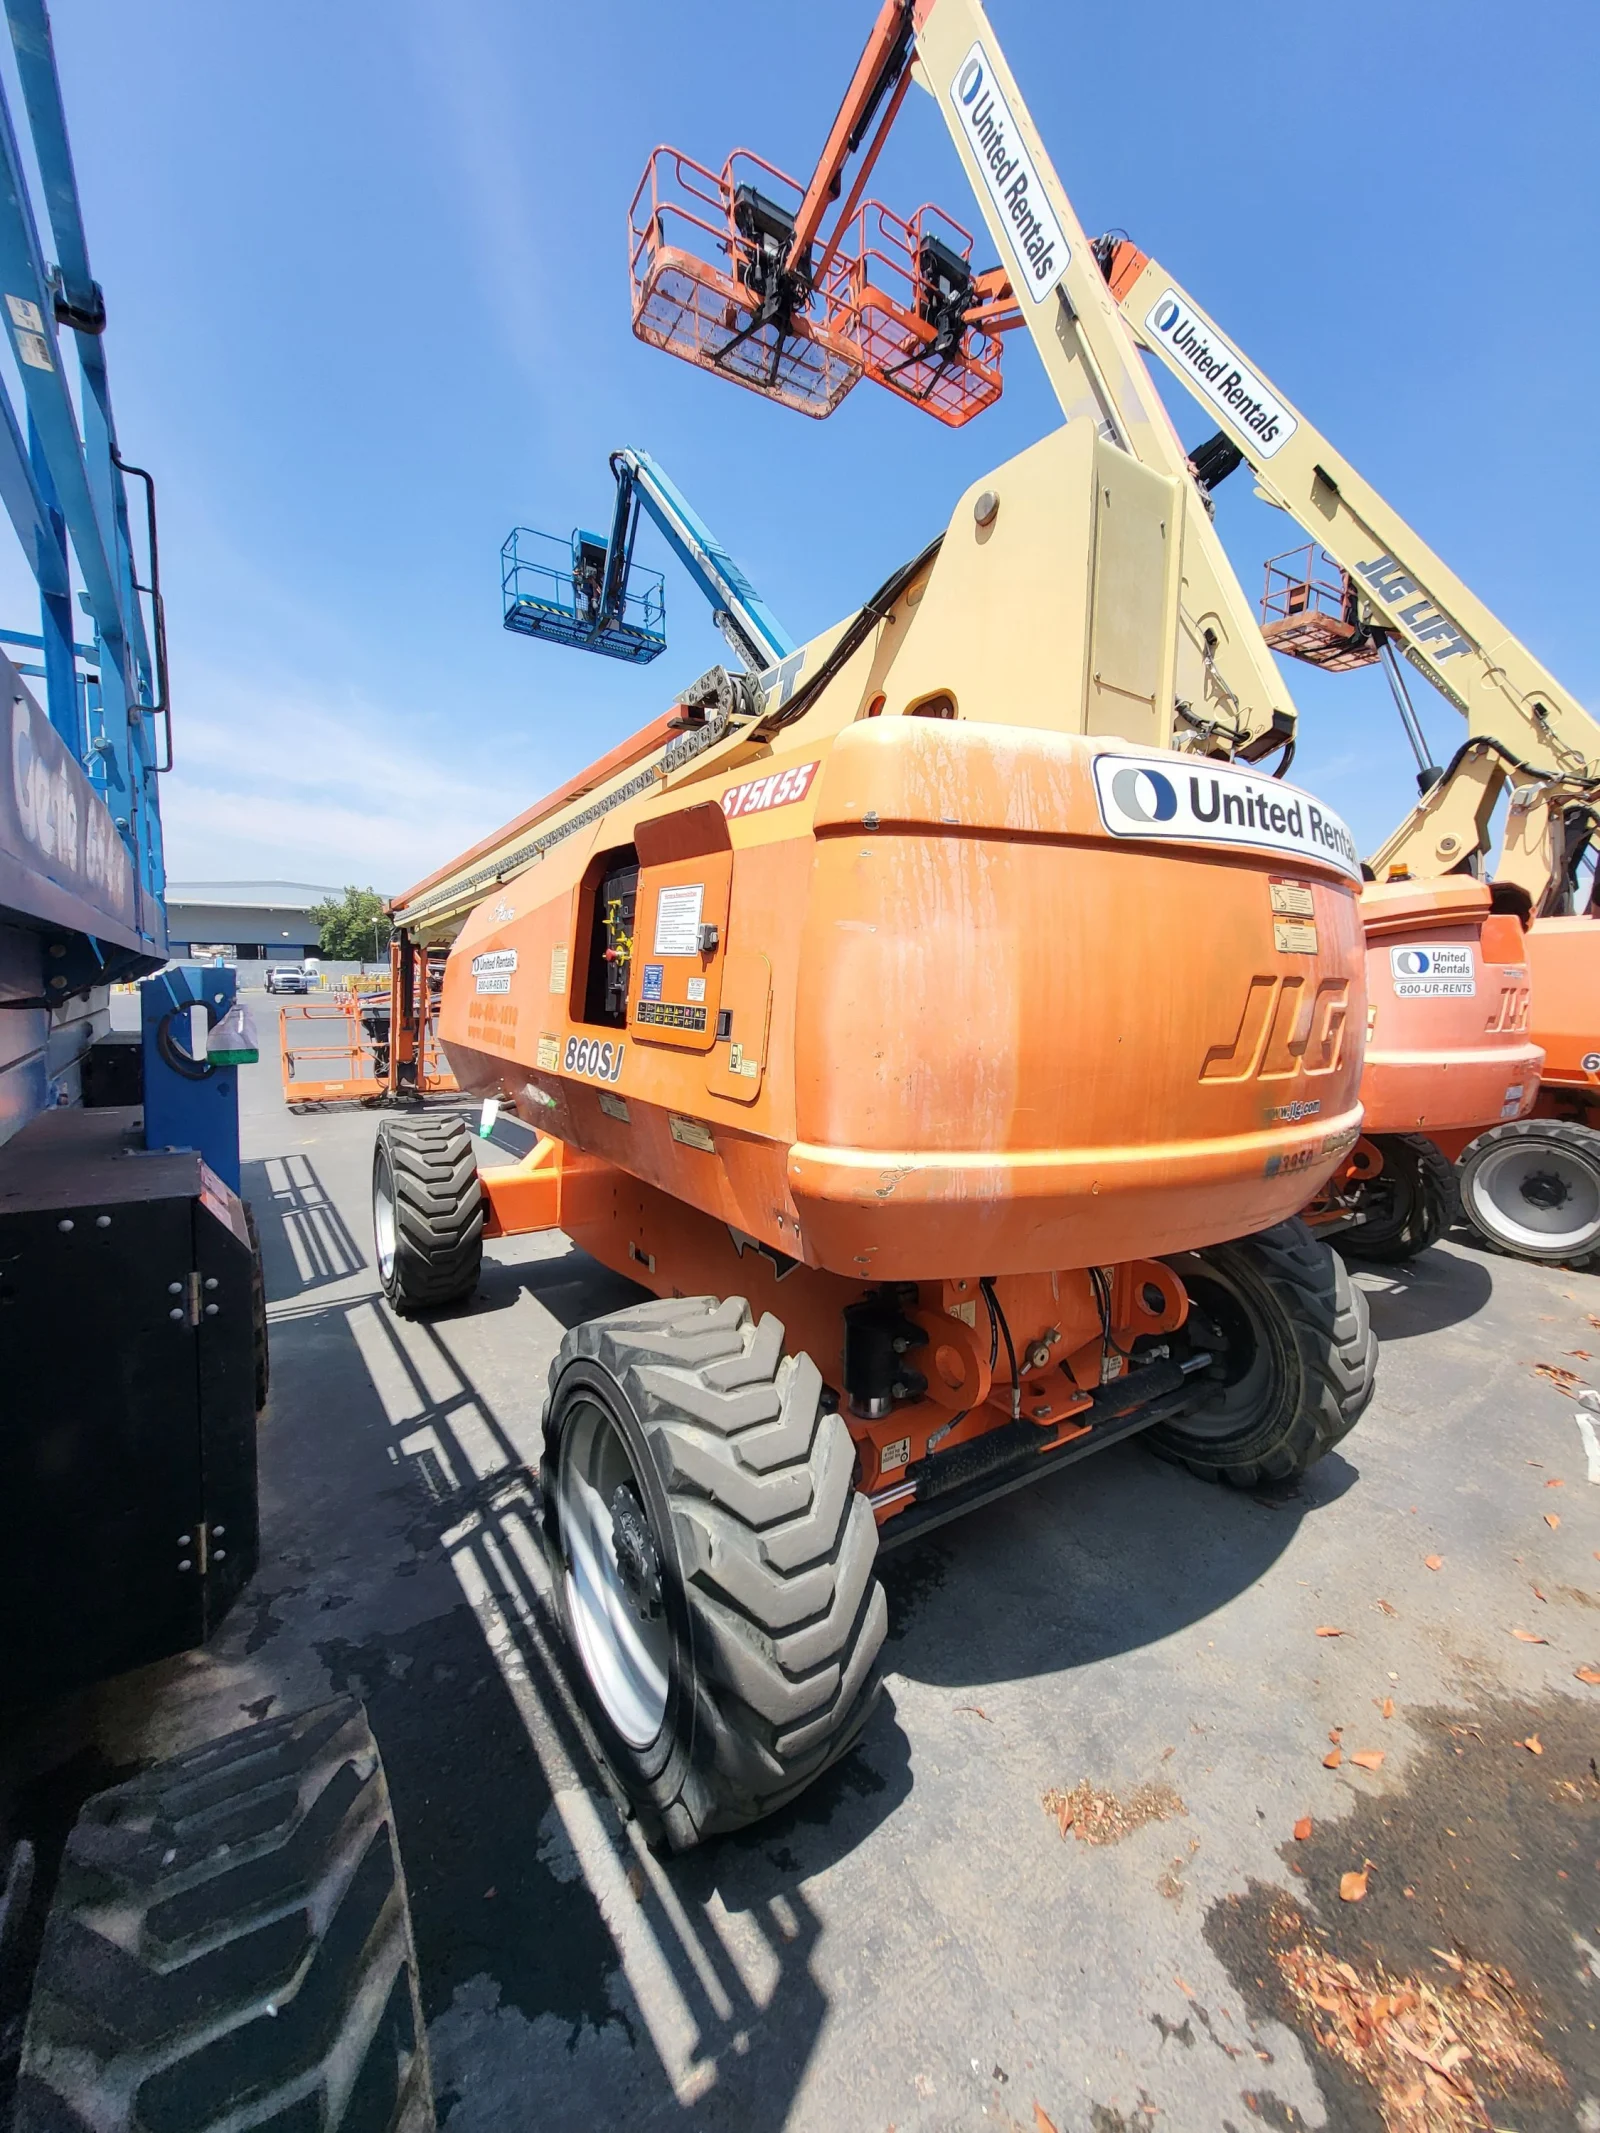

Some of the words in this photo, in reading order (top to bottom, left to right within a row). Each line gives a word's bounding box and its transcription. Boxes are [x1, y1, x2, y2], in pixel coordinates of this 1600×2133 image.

[971, 89, 1019, 187] United
[1004, 171, 1055, 280] Rentals
[1172, 319, 1229, 383] United
[1217, 370, 1279, 443] Rentals
[1353, 553, 1419, 605] JLG
[1396, 599, 1474, 661] LIFT
[1189, 776, 1304, 838] United
[1432, 951, 1466, 963] United
[1433, 963, 1470, 974] Rentals
[1399, 984, 1473, 994] 800-UR-RENTS
[1484, 987, 1530, 1033] JLG
[1199, 975, 1350, 1084] JLG
[564, 1036, 625, 1082] 860SJ
